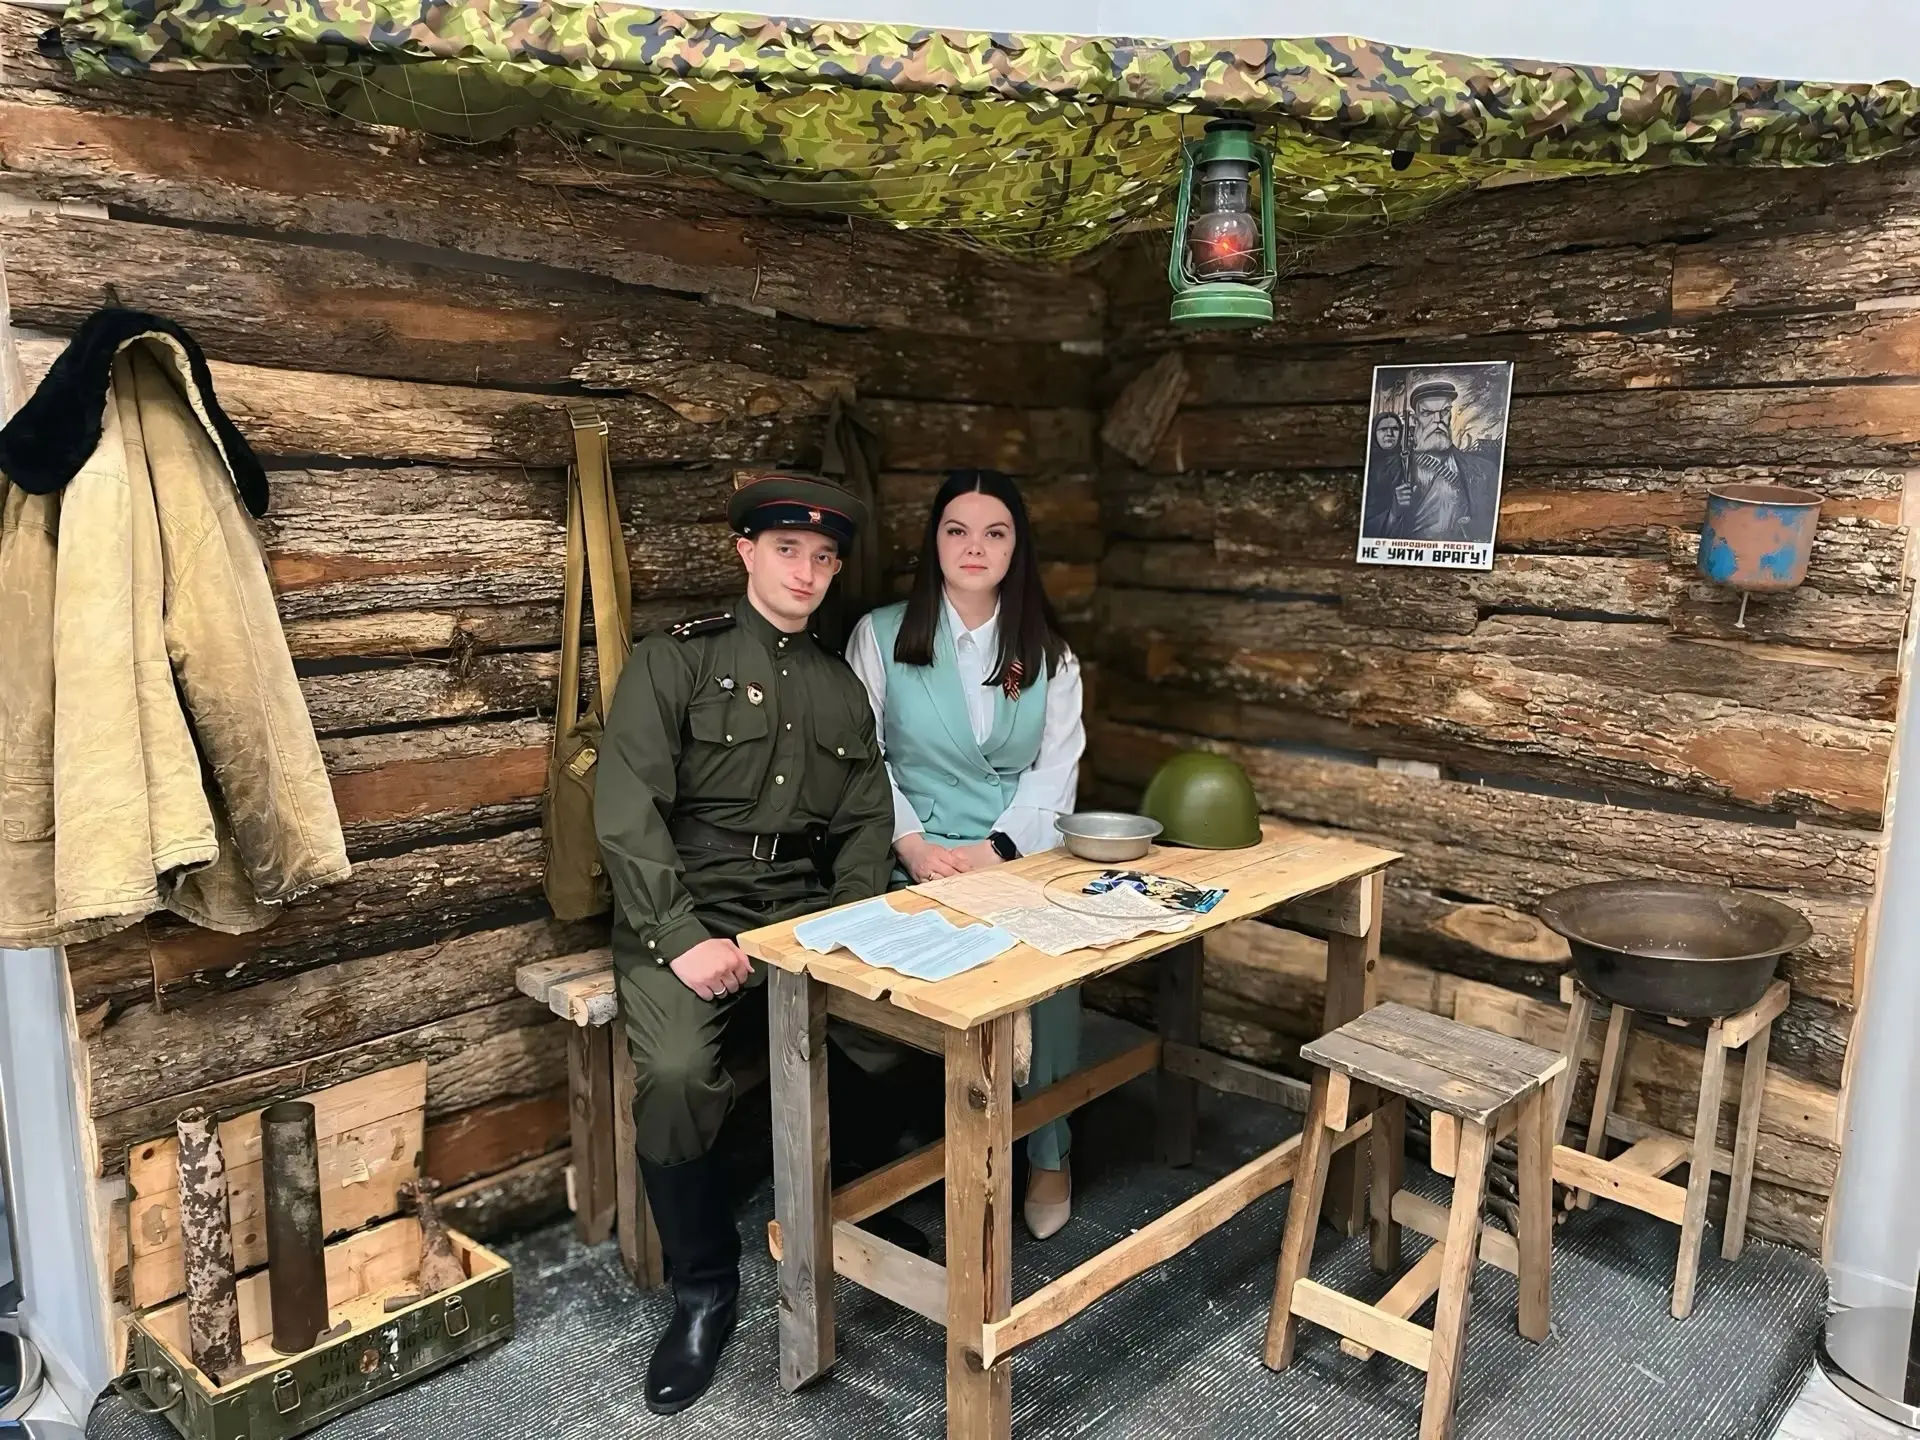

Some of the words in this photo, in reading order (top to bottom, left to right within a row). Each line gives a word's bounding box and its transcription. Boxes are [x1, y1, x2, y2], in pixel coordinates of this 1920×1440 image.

[1391, 540, 1438, 549] НАРОДНОЙ
[1361, 547, 1379, 559] НЕ
[1432, 549, 1488, 565] ВРАГУ!
